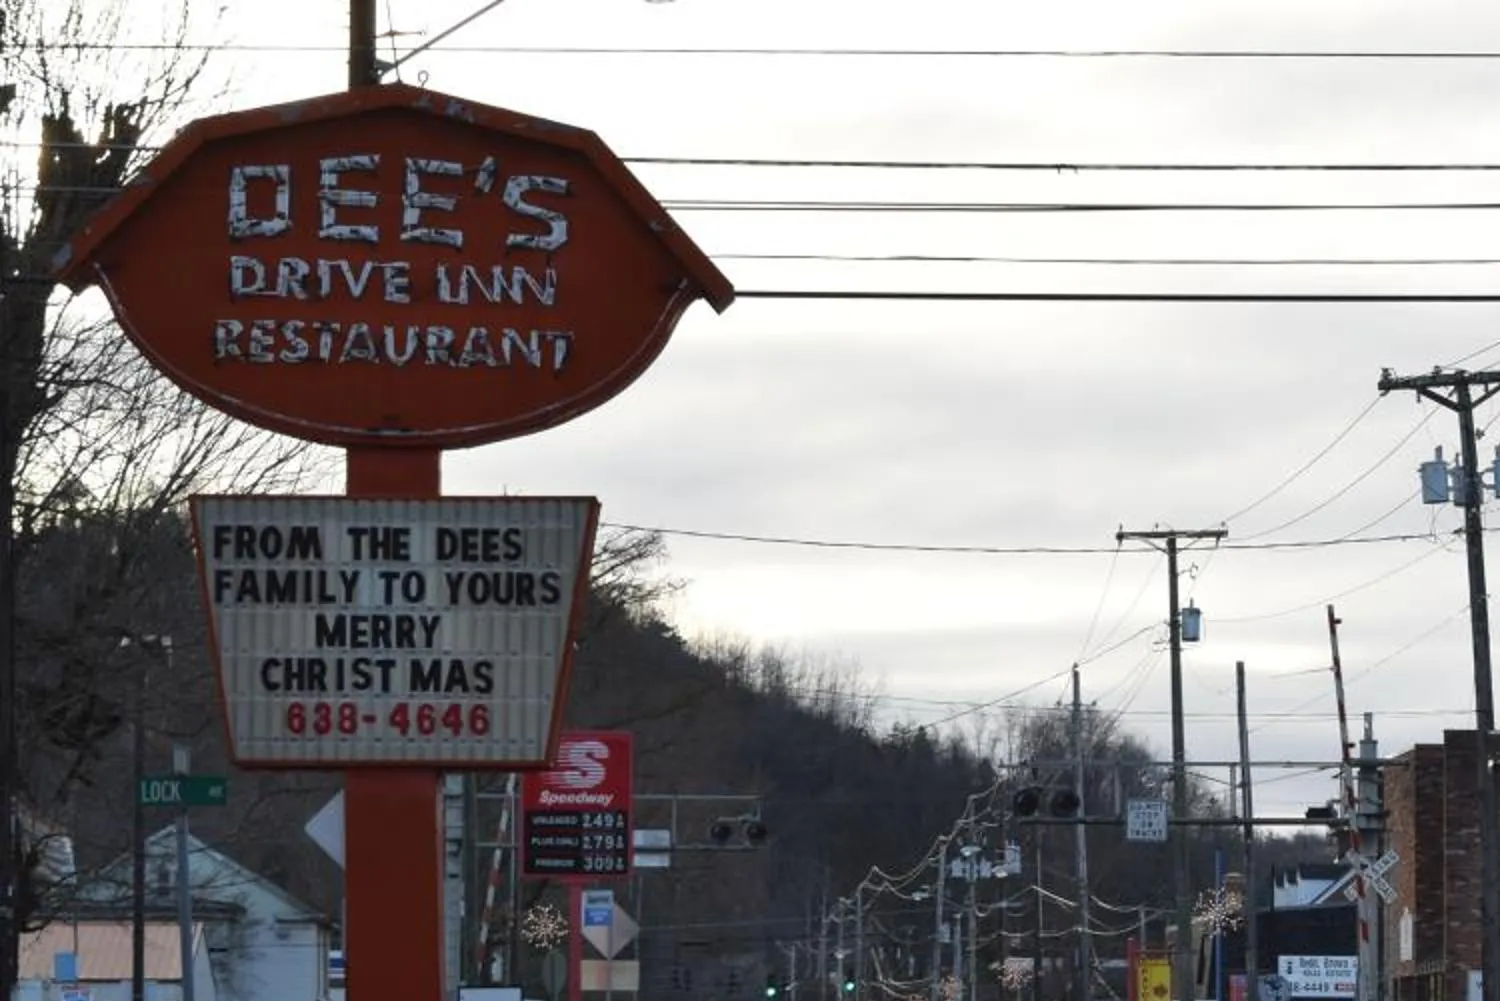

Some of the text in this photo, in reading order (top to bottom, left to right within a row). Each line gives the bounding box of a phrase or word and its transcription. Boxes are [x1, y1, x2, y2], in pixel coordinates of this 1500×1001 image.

[229, 154, 569, 250] DEE'S
[229, 256, 557, 305] DRIVE INN
[212, 319, 574, 372] RESTAURANT
[213, 525, 522, 562] FROM THE DEES
[214, 569, 562, 606] FAMILY TO YOURS
[315, 614, 440, 649] MERRY
[141, 780, 181, 801] LOCK
[539, 791, 615, 806] Speedway
